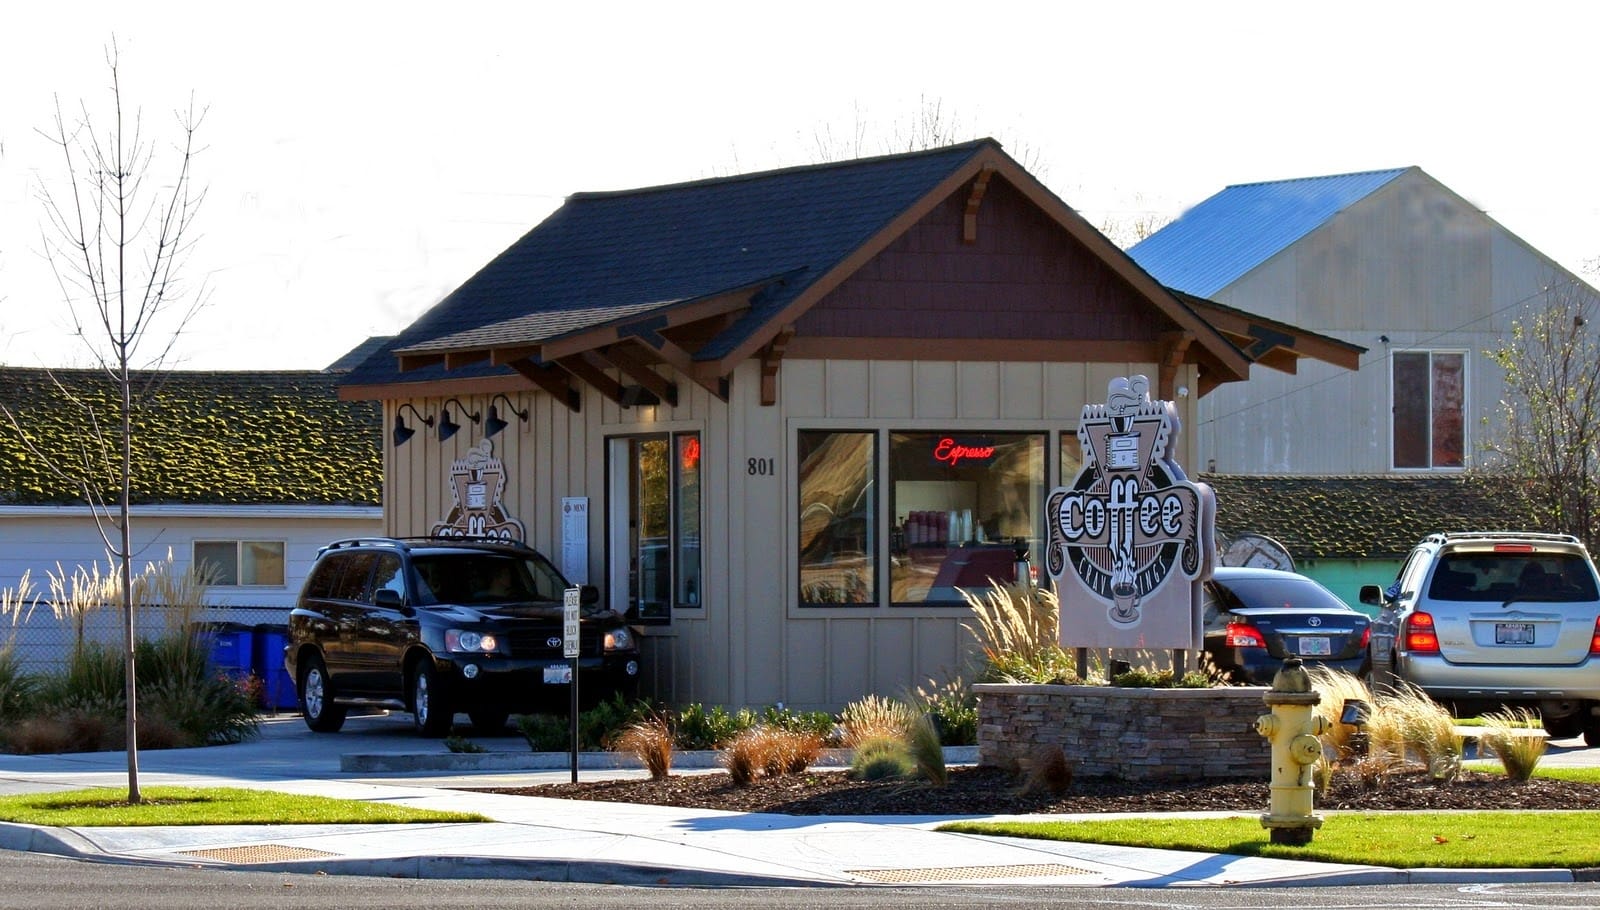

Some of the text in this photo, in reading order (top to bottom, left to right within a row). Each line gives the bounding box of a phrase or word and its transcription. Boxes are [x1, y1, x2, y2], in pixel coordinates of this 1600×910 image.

[934, 438, 995, 466] Espresso
[747, 458, 775, 476] 801
[1058, 476, 1183, 562] Coffee
